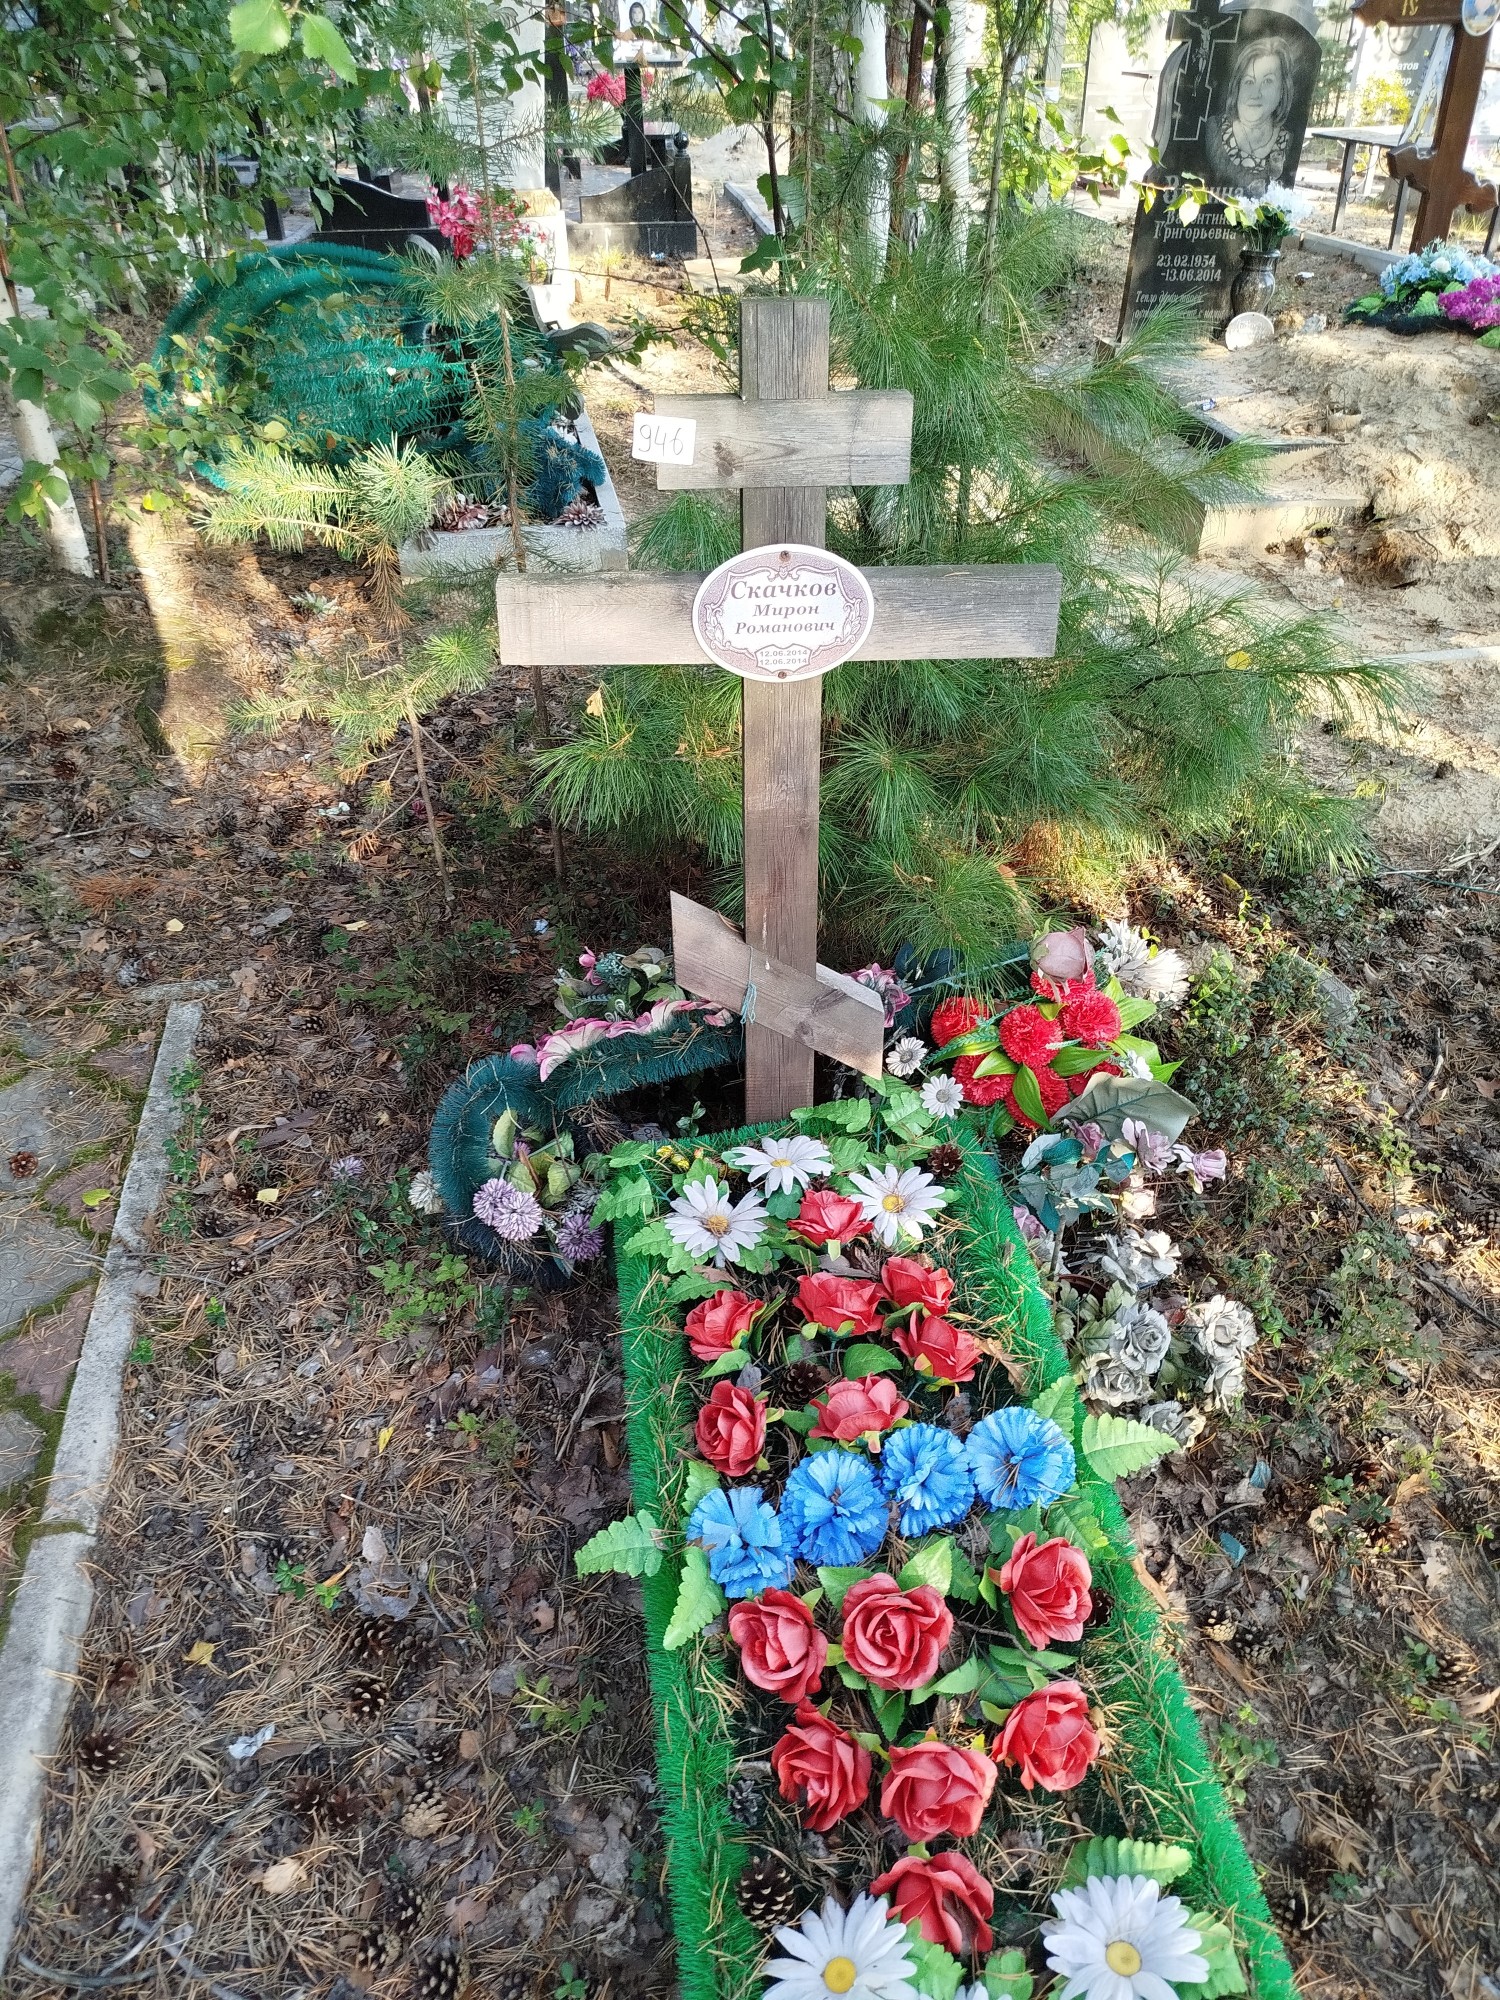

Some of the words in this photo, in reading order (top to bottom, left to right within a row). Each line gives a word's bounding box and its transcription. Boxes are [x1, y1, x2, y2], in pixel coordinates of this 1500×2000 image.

[1153, 220, 1236, 242] Григорьевна
[1156, 254, 1217, 268] 23.02.1954
[638, 423, 684, 457] 946
[731, 580, 837, 600] Скачков
[752, 604, 820, 619] Мирон
[735, 620, 836, 635] Романович
[759, 649, 809, 657] 12.06.2014
[759, 658, 808, 666] 12.06.2014
